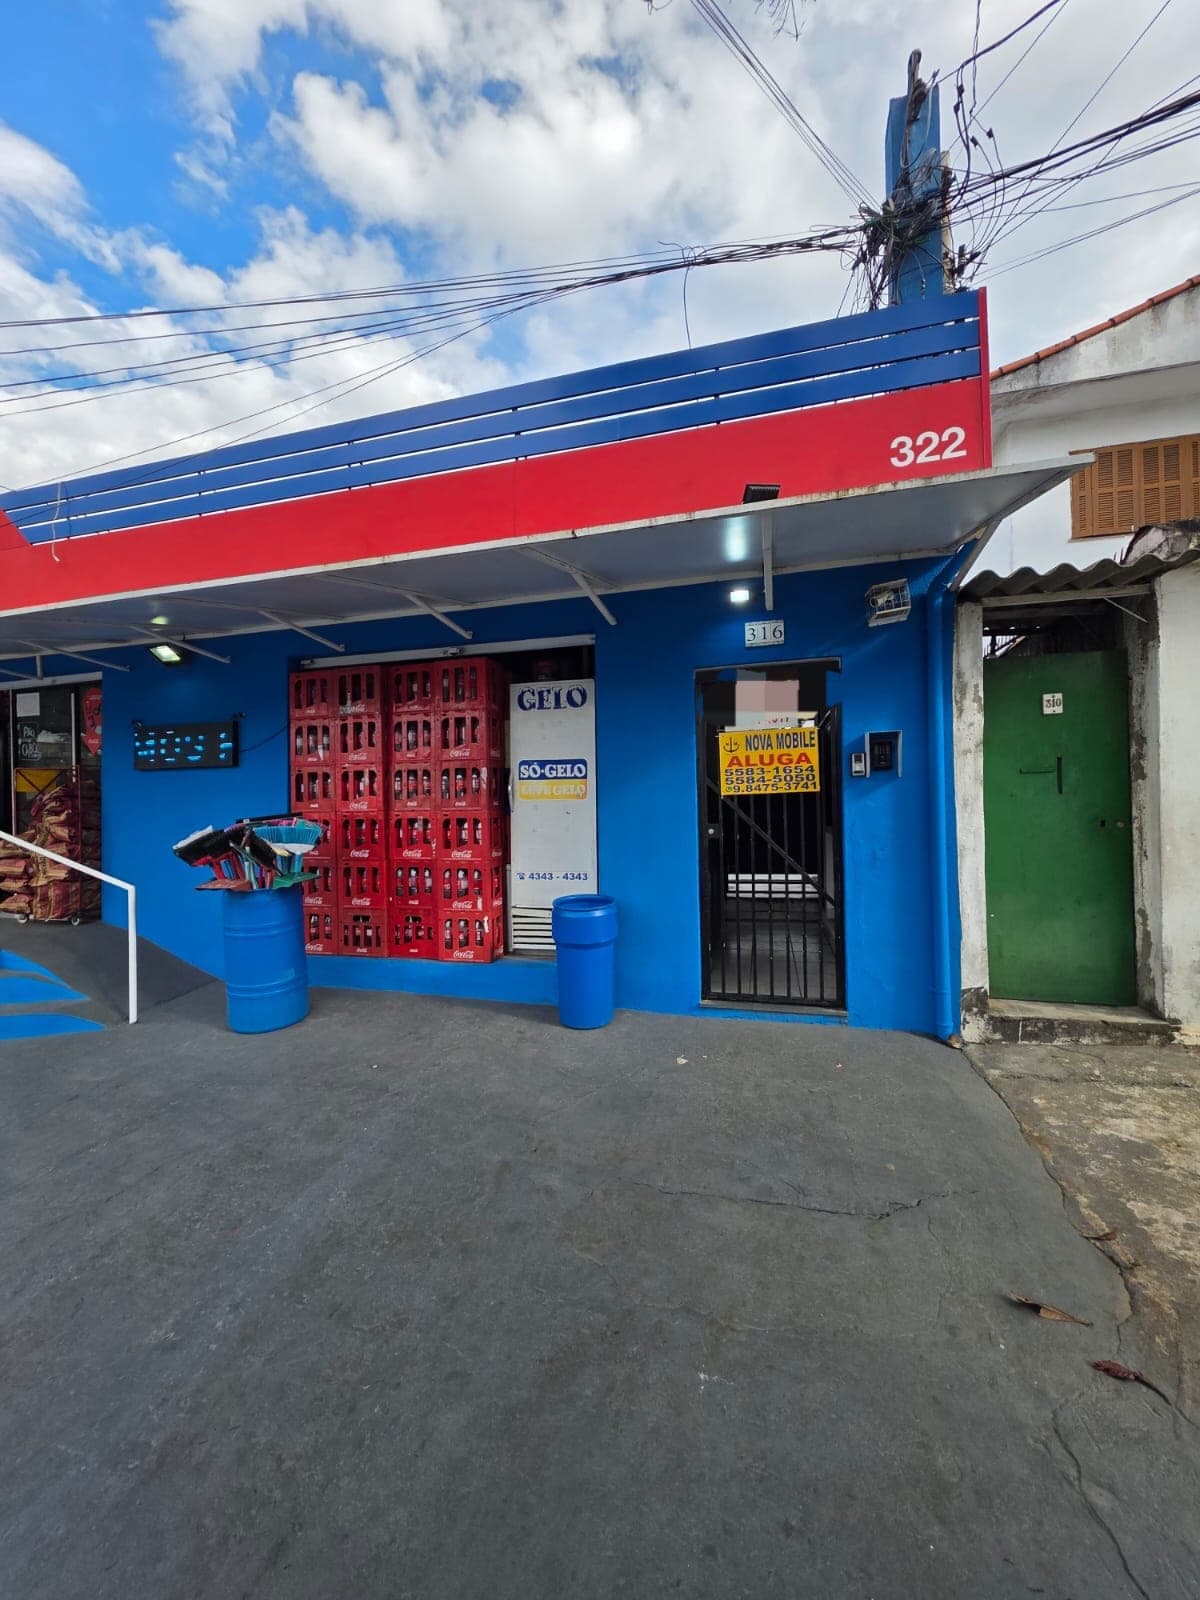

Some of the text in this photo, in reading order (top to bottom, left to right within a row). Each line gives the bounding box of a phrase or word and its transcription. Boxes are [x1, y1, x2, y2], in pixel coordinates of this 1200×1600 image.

[890, 426, 967, 467] 322
[747, 625, 782, 641] 316
[517, 686, 587, 711] GELO
[745, 731, 816, 751] NOVA MOBILE
[727, 752, 812, 767] ALUGA
[724, 765, 815, 776] 5583-1654
[725, 774, 816, 785] 5584-5050
[733, 782, 817, 793] 9.8475-3741
[528, 872, 553, 880] 4343
[562, 872, 588, 881] 4343
